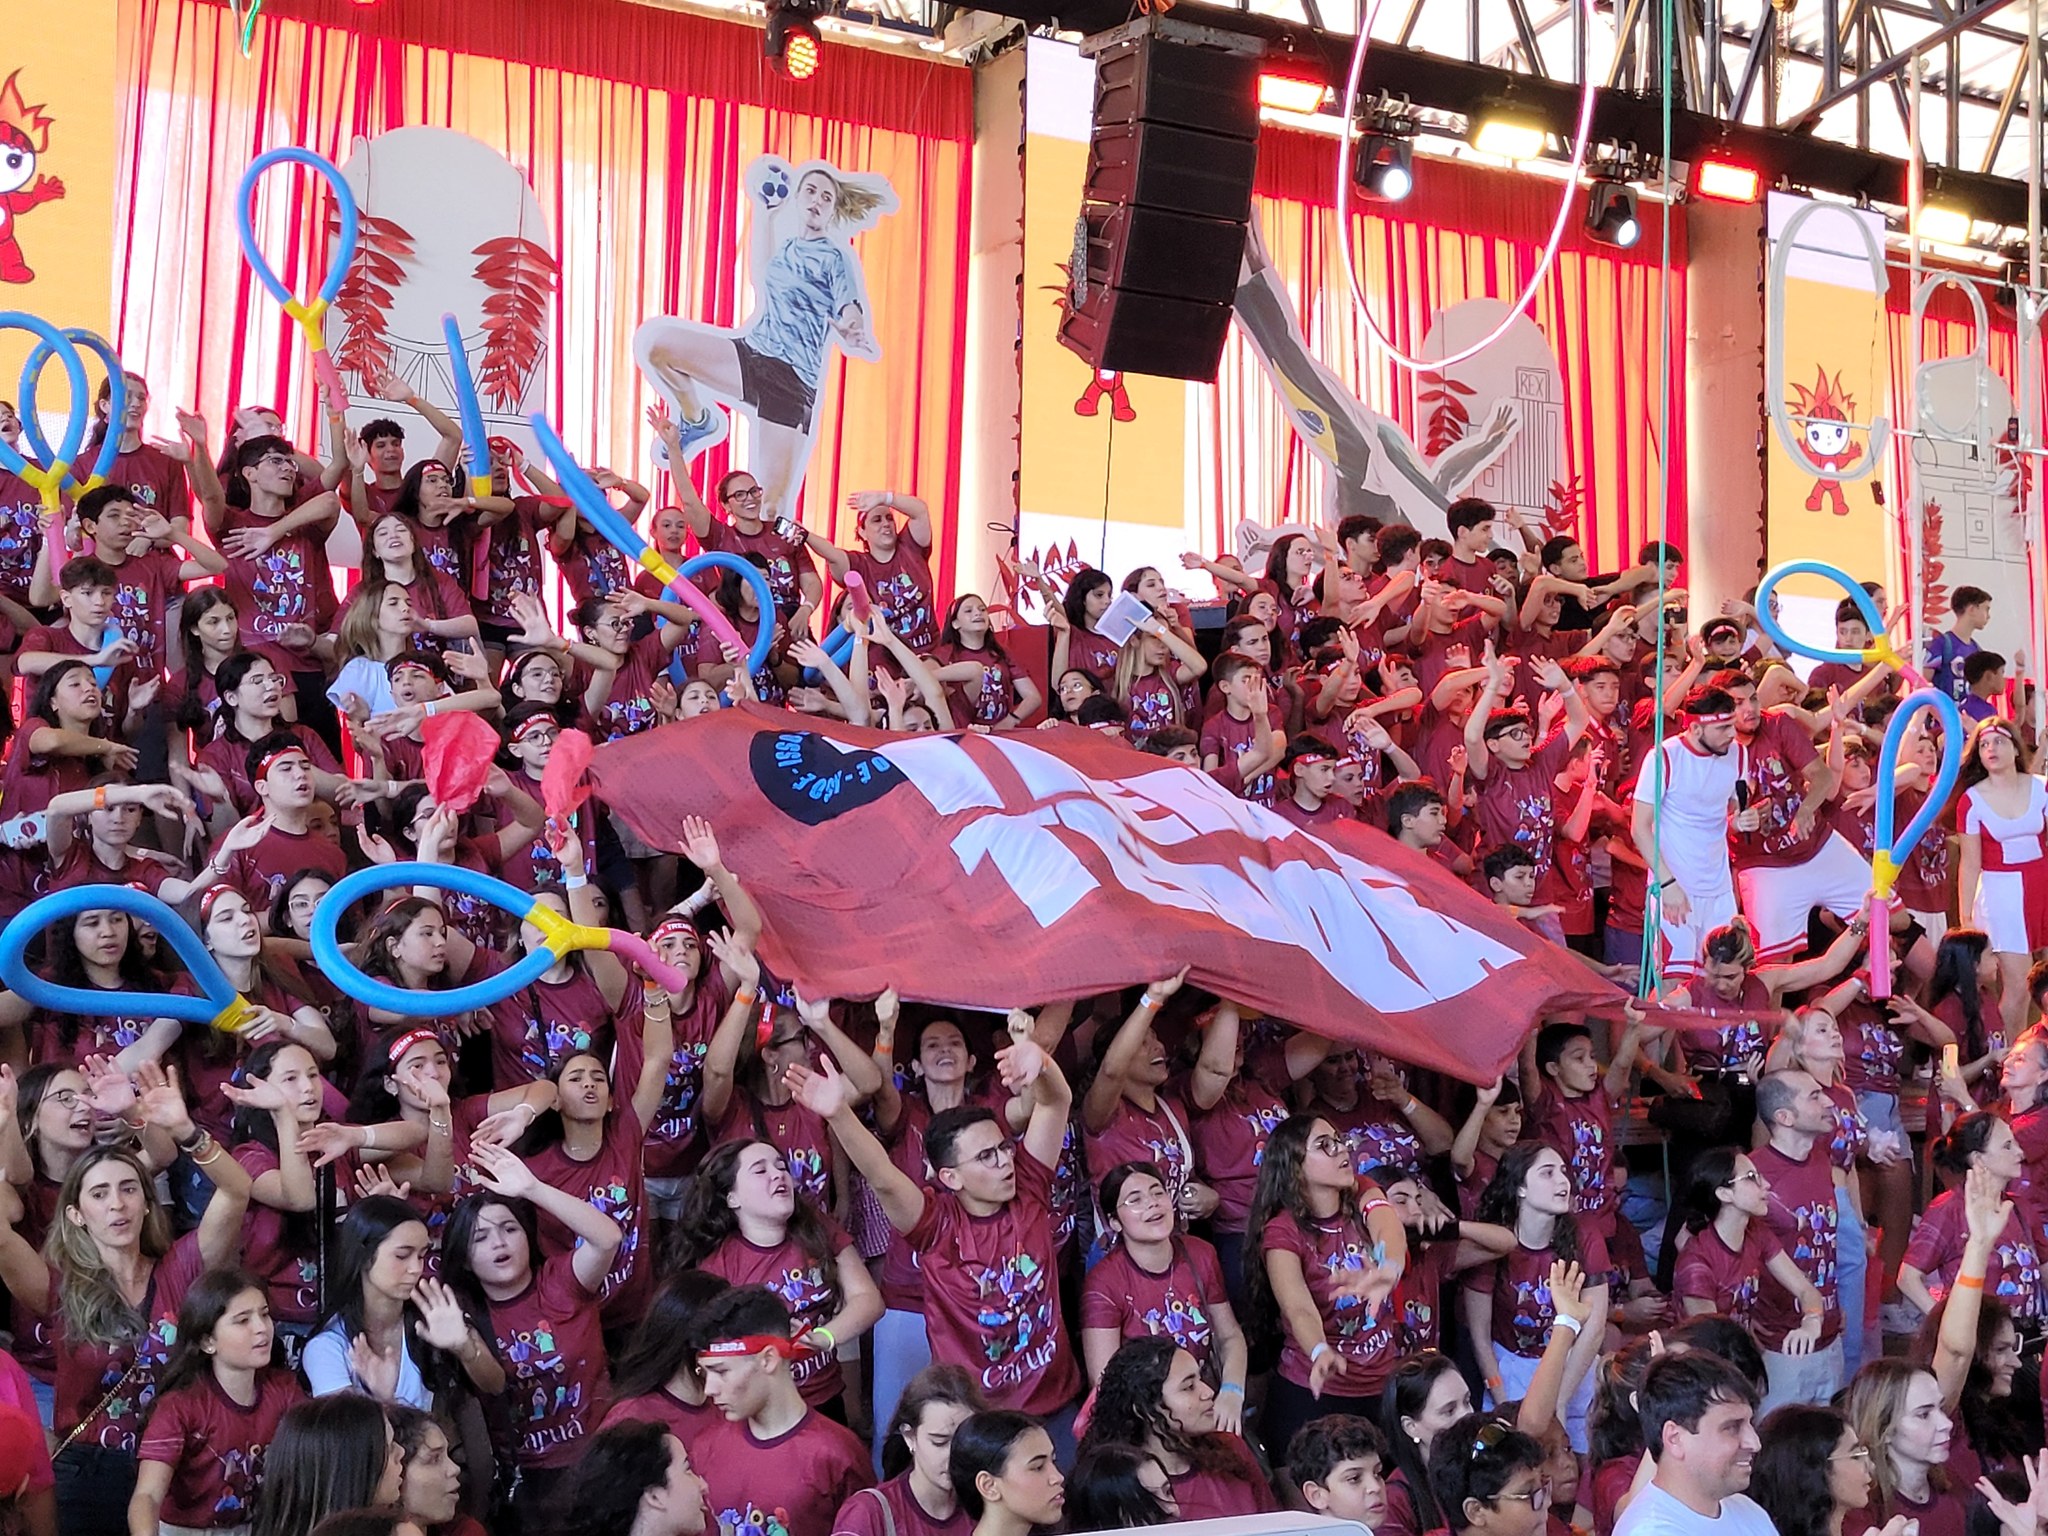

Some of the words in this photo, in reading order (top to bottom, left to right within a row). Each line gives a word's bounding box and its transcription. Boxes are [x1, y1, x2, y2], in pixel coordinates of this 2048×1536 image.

[1520, 372, 1544, 397] REX
[982, 1334, 1057, 1388] Caruá
[516, 1413, 585, 1454] aruá
